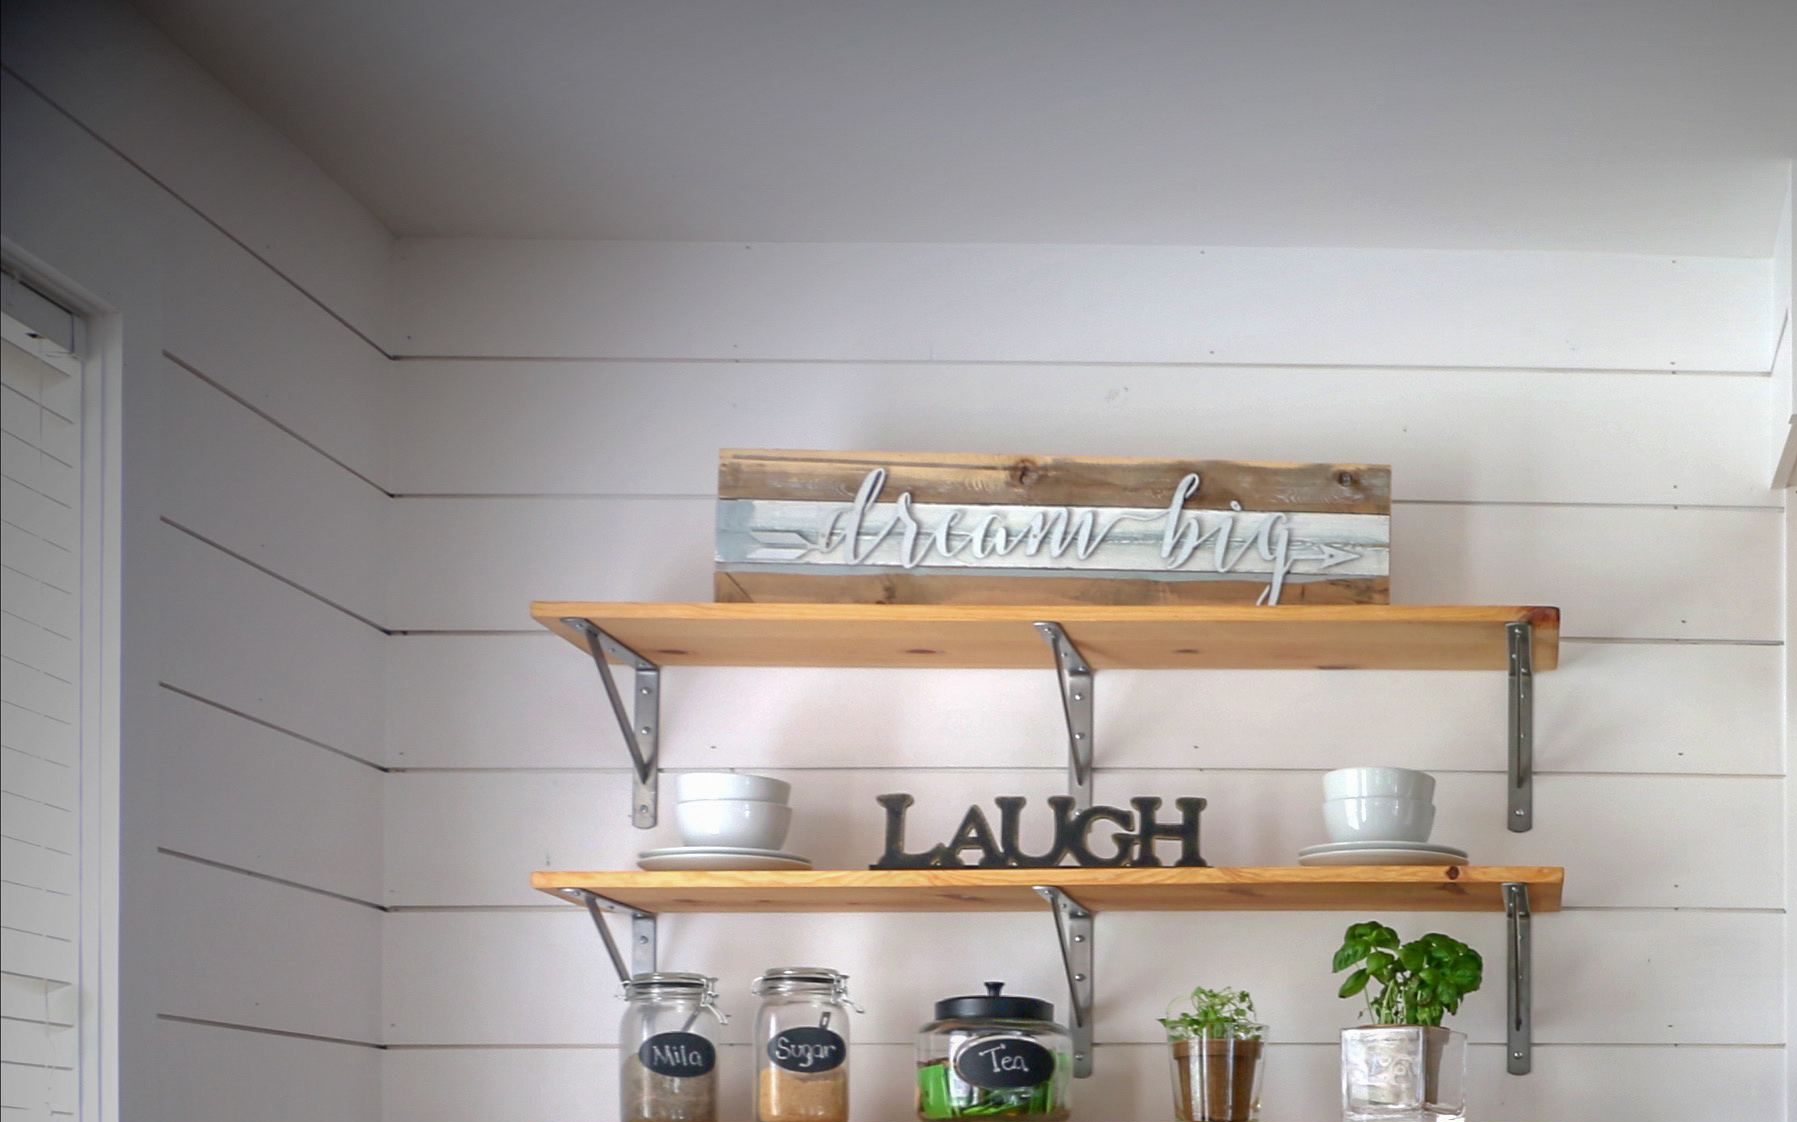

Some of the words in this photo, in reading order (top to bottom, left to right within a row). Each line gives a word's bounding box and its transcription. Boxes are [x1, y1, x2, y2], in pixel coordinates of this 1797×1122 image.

[817, 468, 1113, 569] dream
[1163, 472, 1293, 606] big
[875, 793, 1209, 868] LAUGH
[652, 1045, 704, 1066] Mila
[774, 1036, 837, 1068] Sugar
[977, 1043, 1030, 1073] Tea
